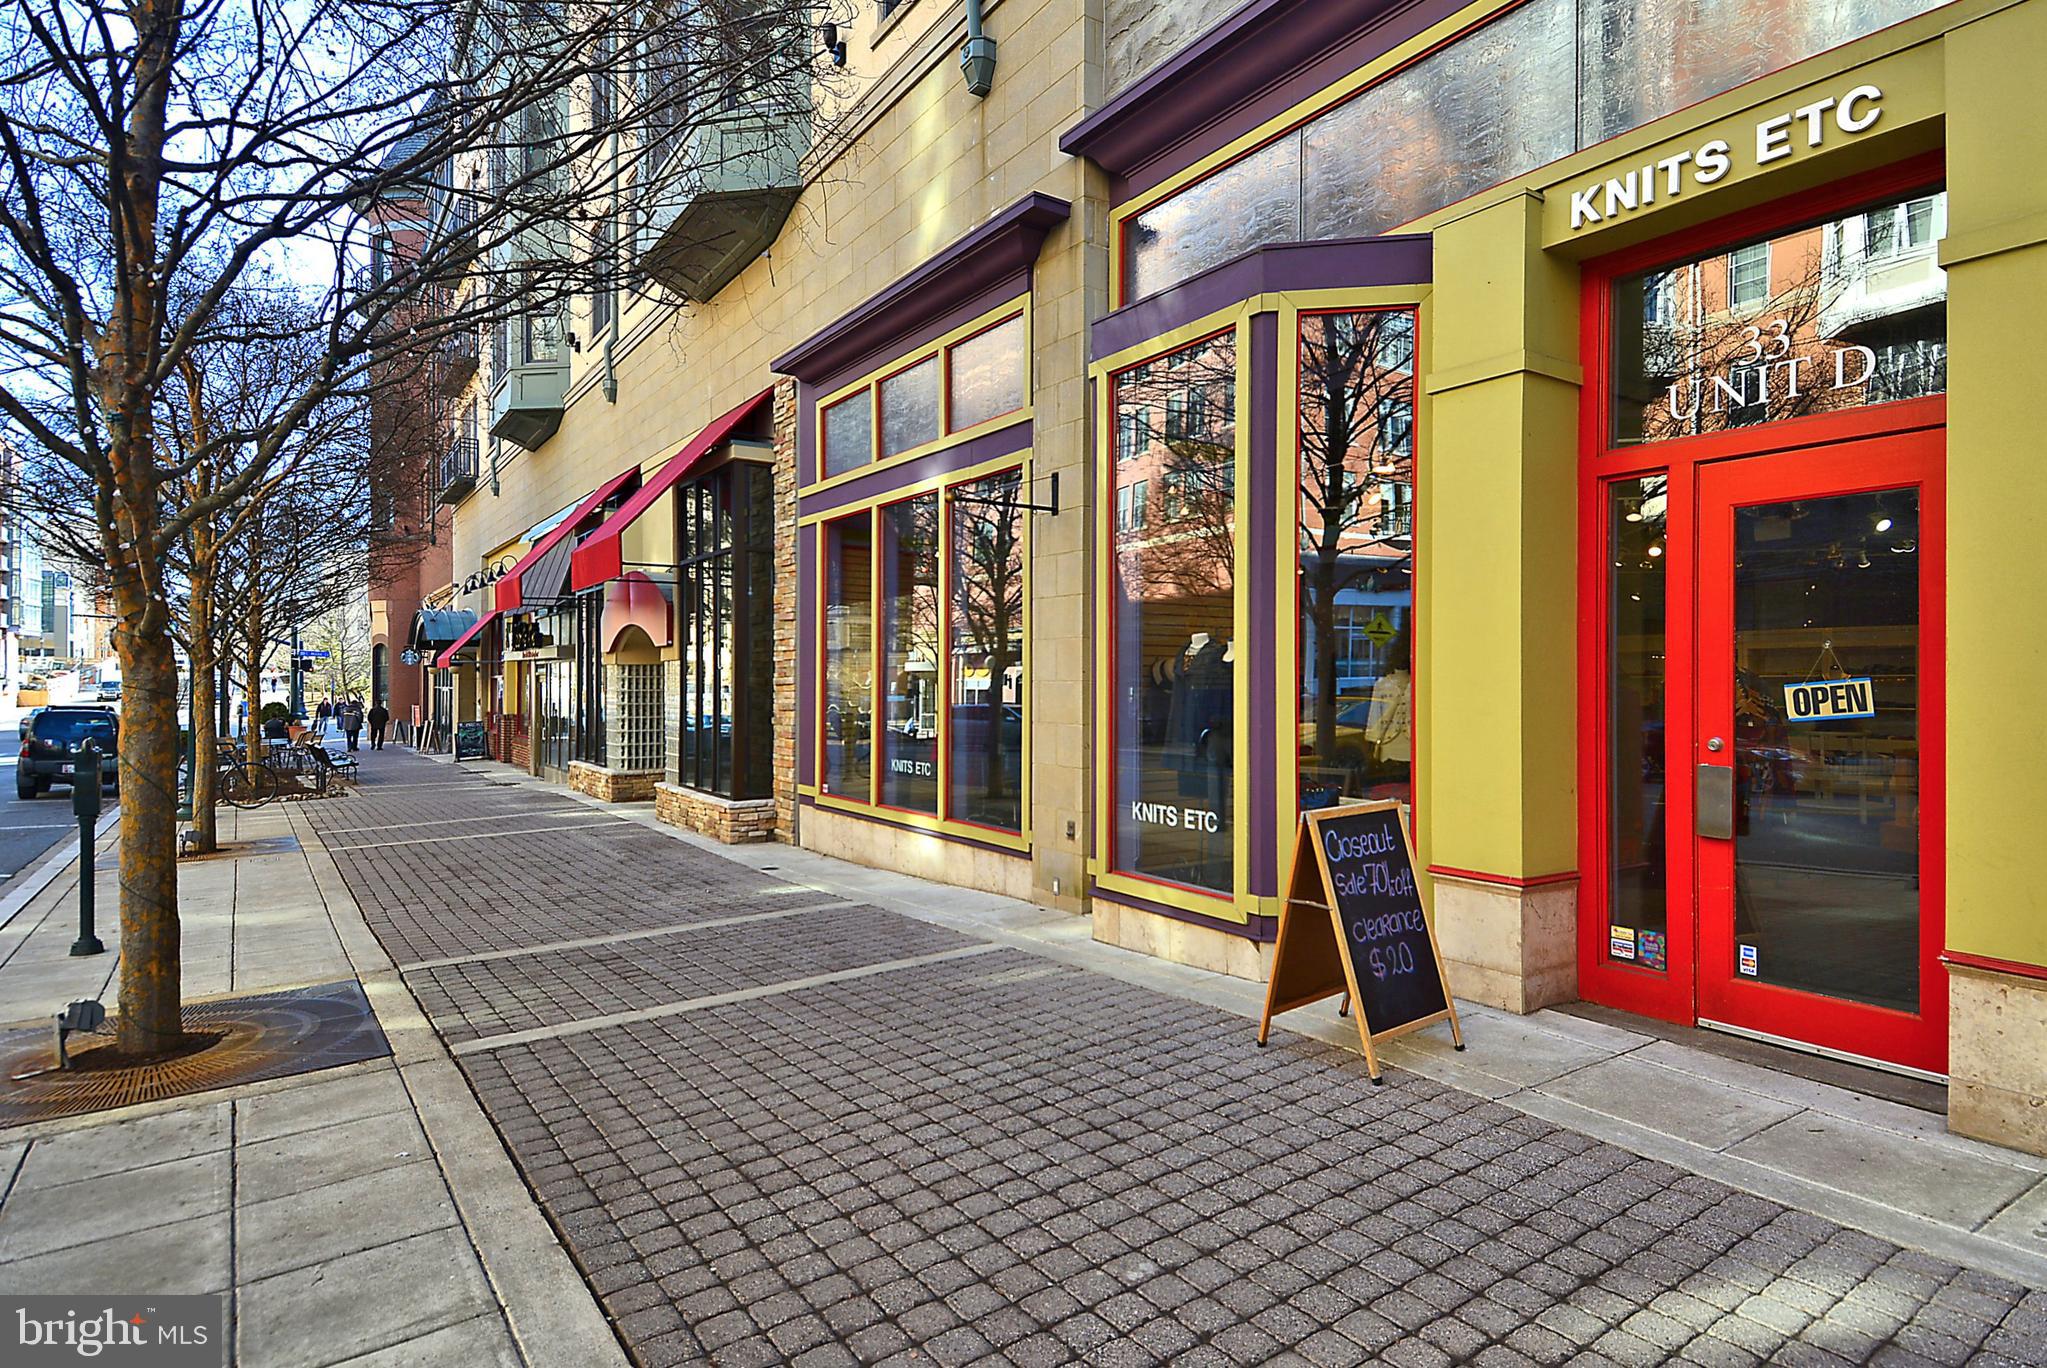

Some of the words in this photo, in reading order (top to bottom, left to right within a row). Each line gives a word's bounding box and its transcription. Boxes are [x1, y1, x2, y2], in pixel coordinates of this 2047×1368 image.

[1570, 138, 1731, 230] KNITS
[1756, 84, 1883, 166] ETC
[1738, 319, 1790, 366] 33
[1665, 356, 1811, 420] UNIT
[1829, 345, 1877, 391] D
[1792, 682, 1868, 717] OPEN
[891, 759, 913, 774] KNITS
[915, 761, 931, 776] ETC
[1131, 801, 1178, 827] KNITS
[1184, 808, 1218, 833] ETC
[1325, 823, 1396, 863] Closeout
[1335, 872, 1367, 897] Sale
